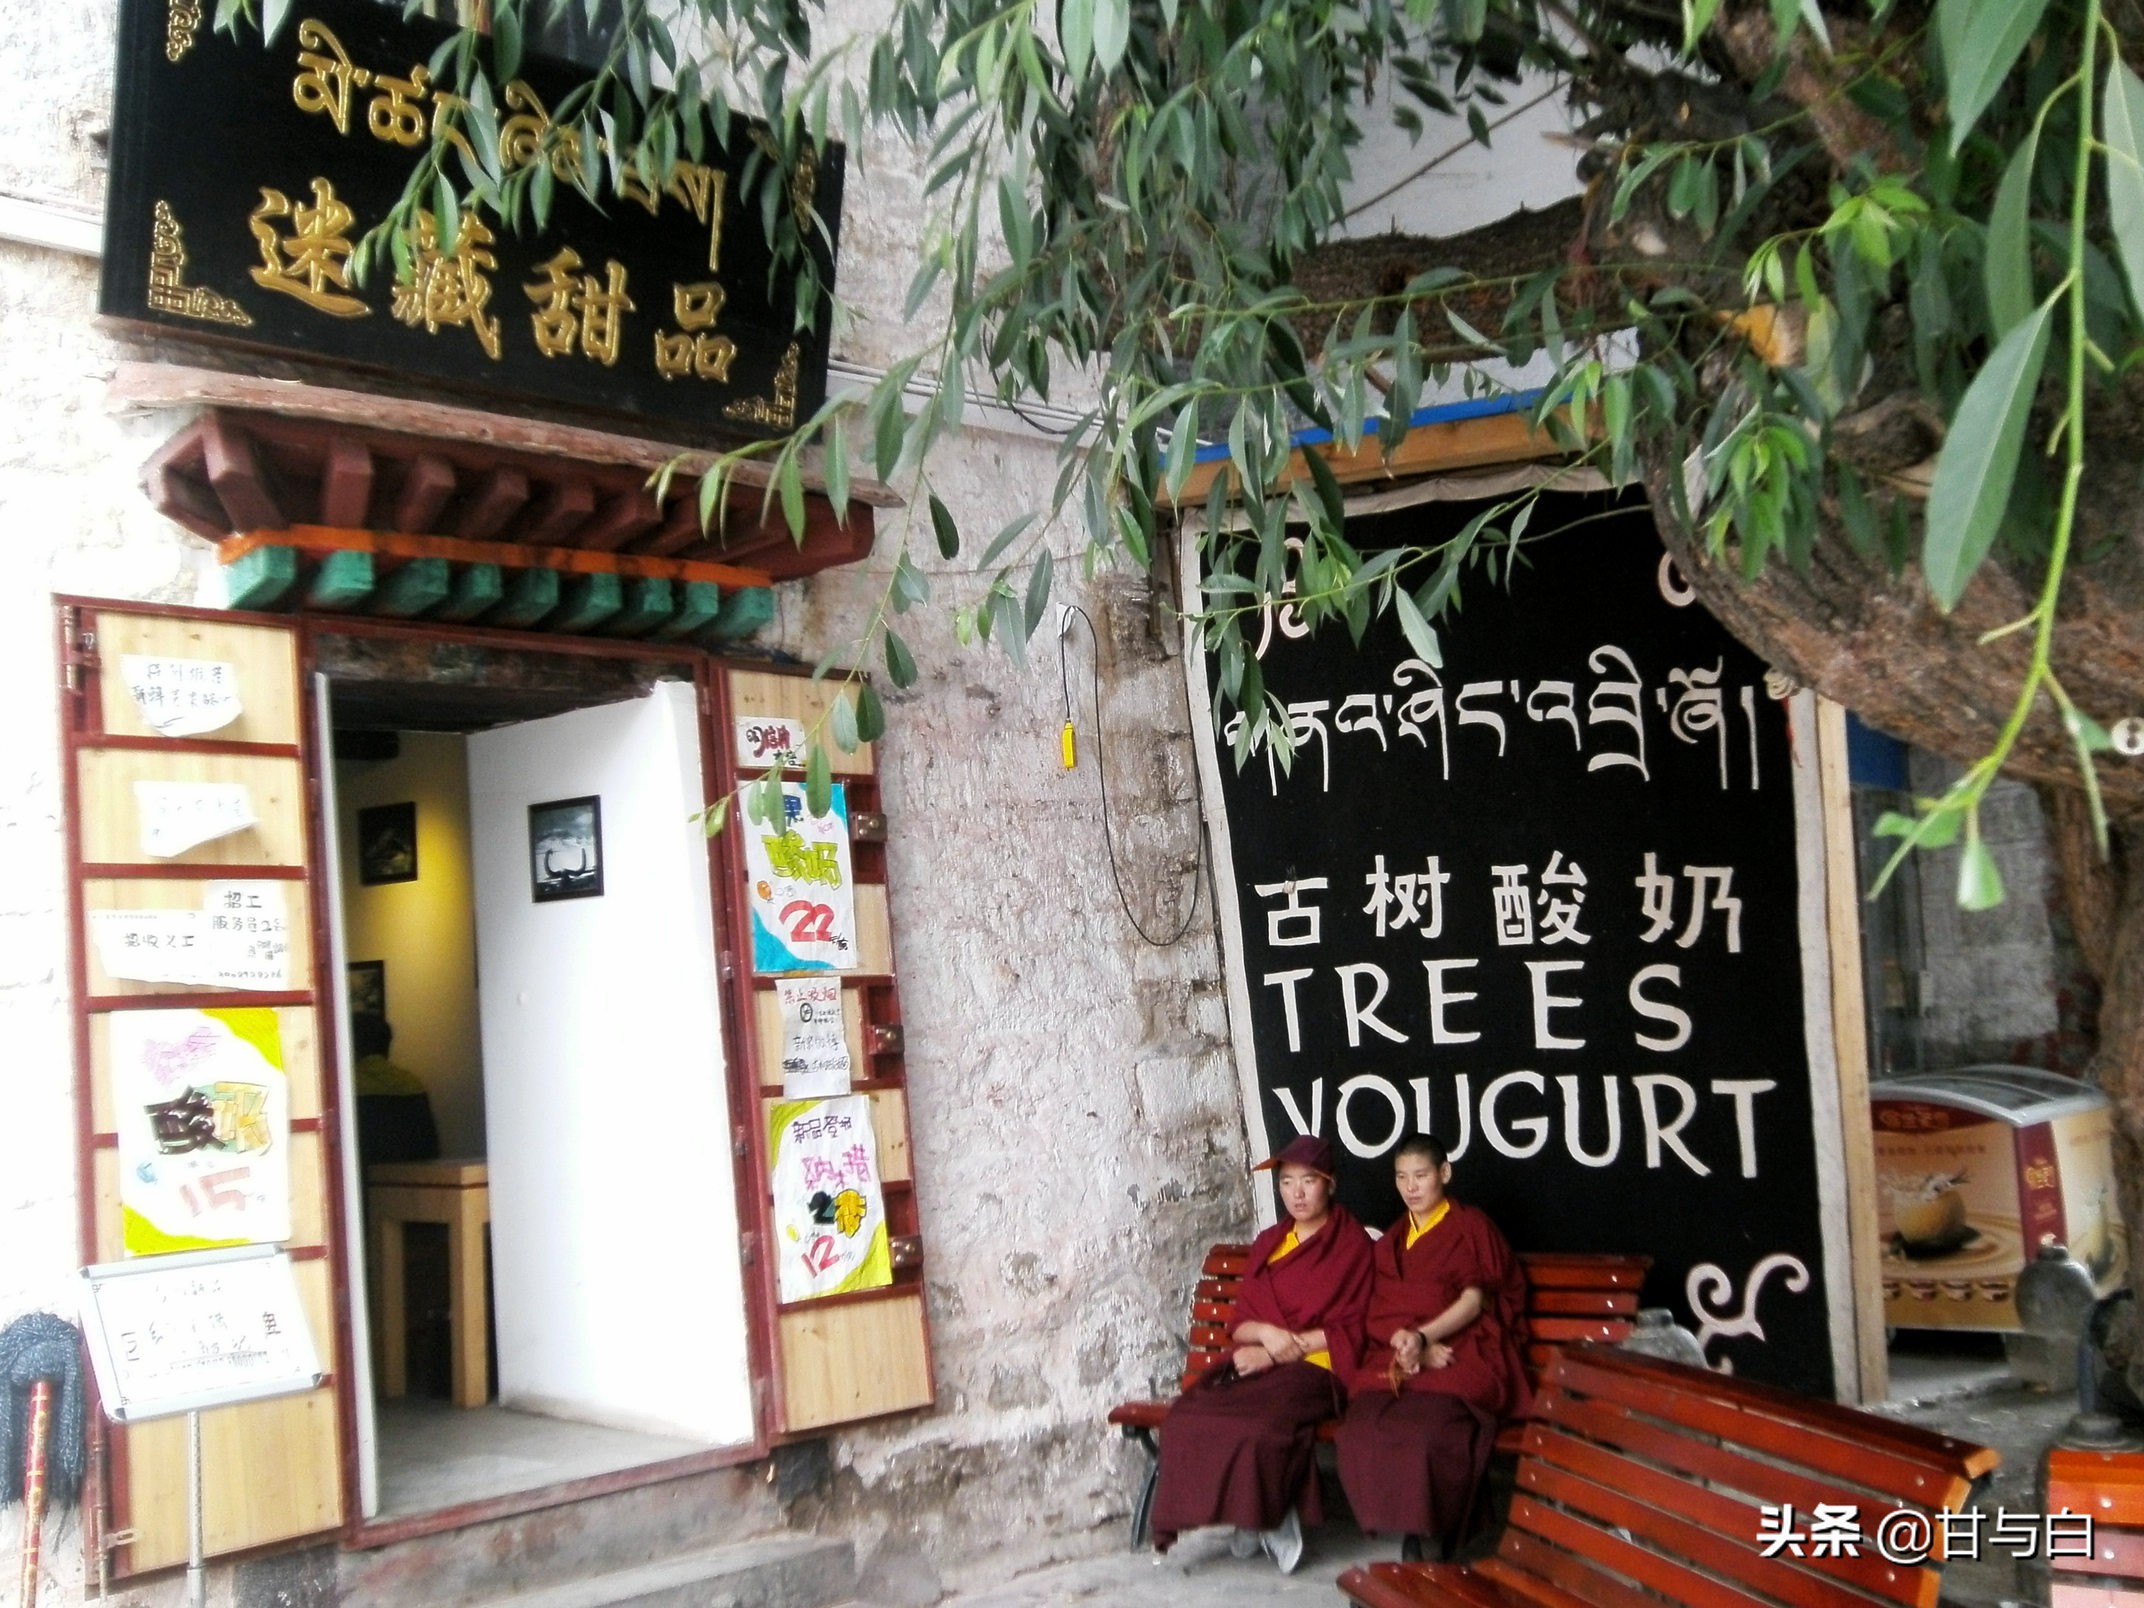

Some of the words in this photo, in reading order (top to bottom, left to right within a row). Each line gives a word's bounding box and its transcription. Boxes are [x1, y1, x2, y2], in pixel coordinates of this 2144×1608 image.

[249, 177, 737, 384] 迷藏甜品
[778, 900, 835, 942] 22
[1255, 850, 1743, 953] 古树酸奶
[1263, 958, 1693, 1053] TREES
[801, 1235, 840, 1279] 12
